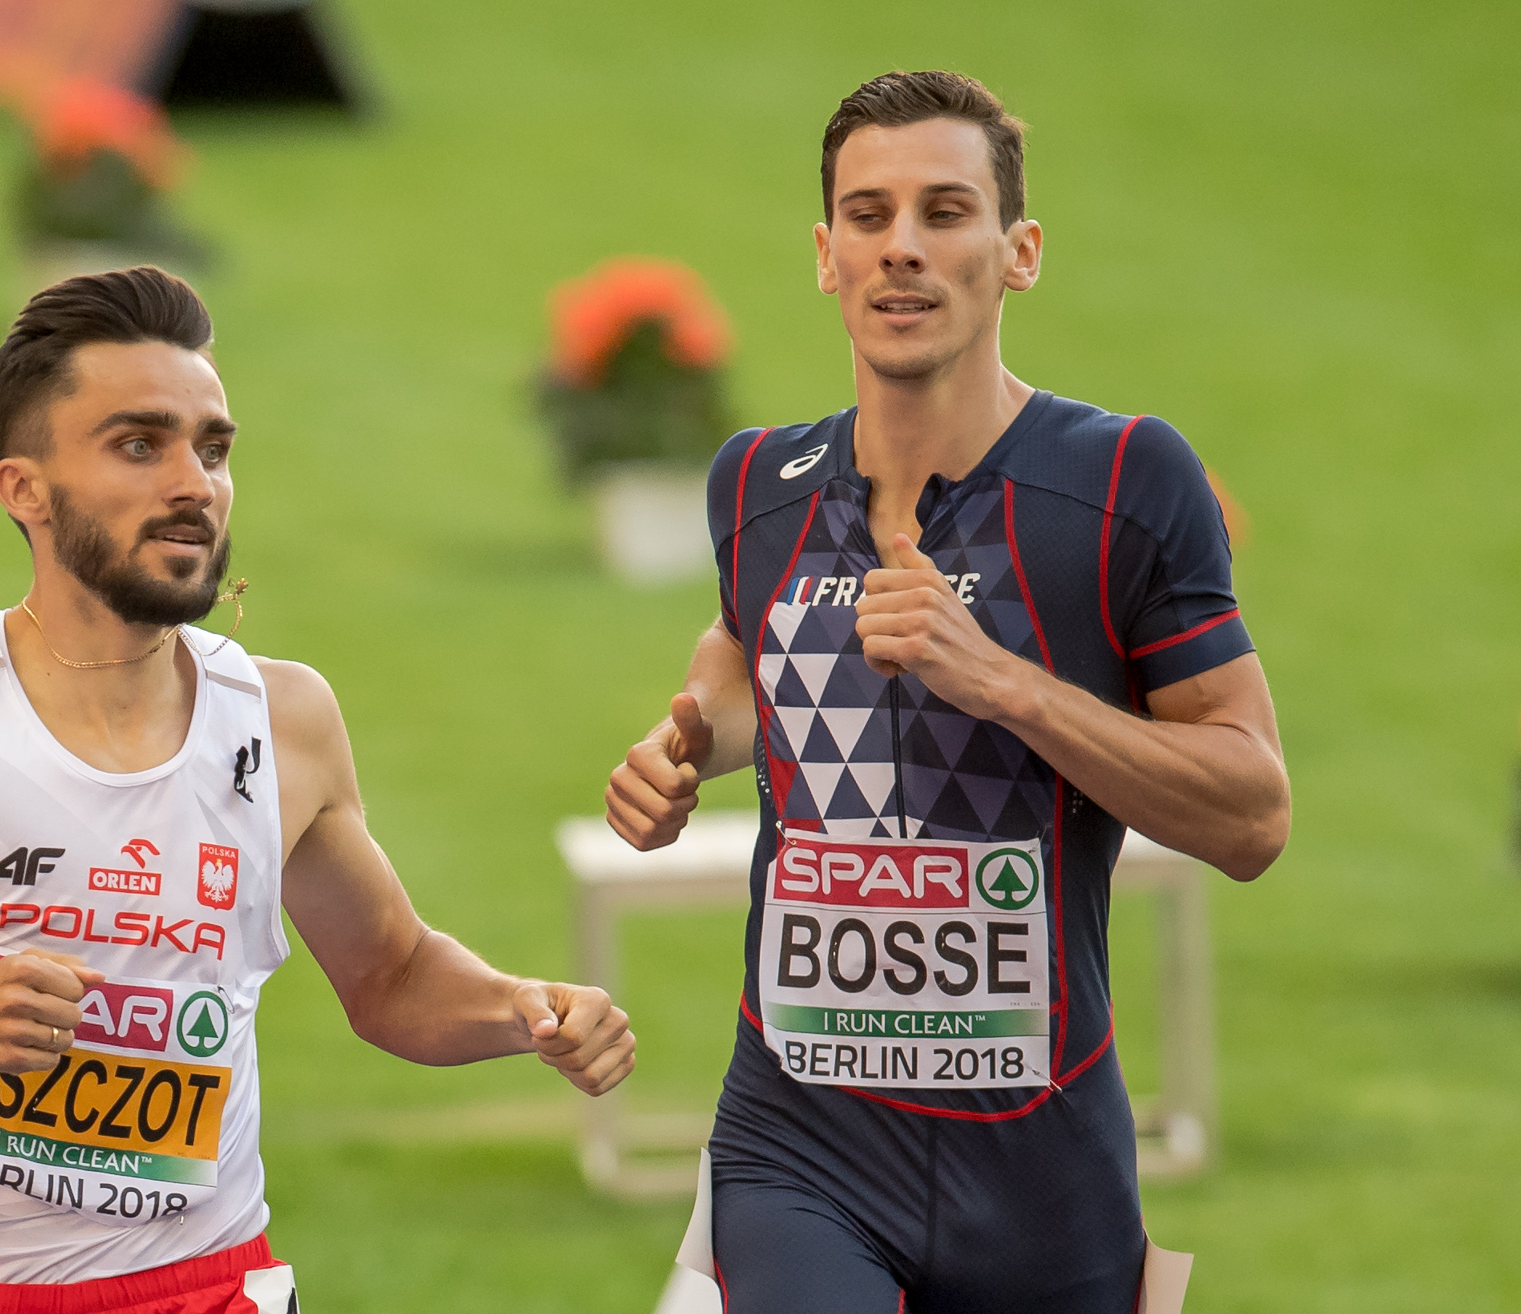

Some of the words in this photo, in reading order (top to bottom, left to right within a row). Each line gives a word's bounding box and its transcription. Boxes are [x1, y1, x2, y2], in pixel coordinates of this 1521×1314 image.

[812, 573, 981, 606] FRE
[202, 845, 237, 859] POLSKA
[93, 872, 157, 893] ORLEN
[781, 847, 963, 899] SPAR
[777, 913, 1031, 996] BOSSE
[824, 1012, 829, 1031] I
[837, 1013, 886, 1033] RUN
[785, 1041, 918, 1080] BERLIN
[933, 1046, 1024, 1081] 2018
[7, 1135, 57, 1161] RUN
